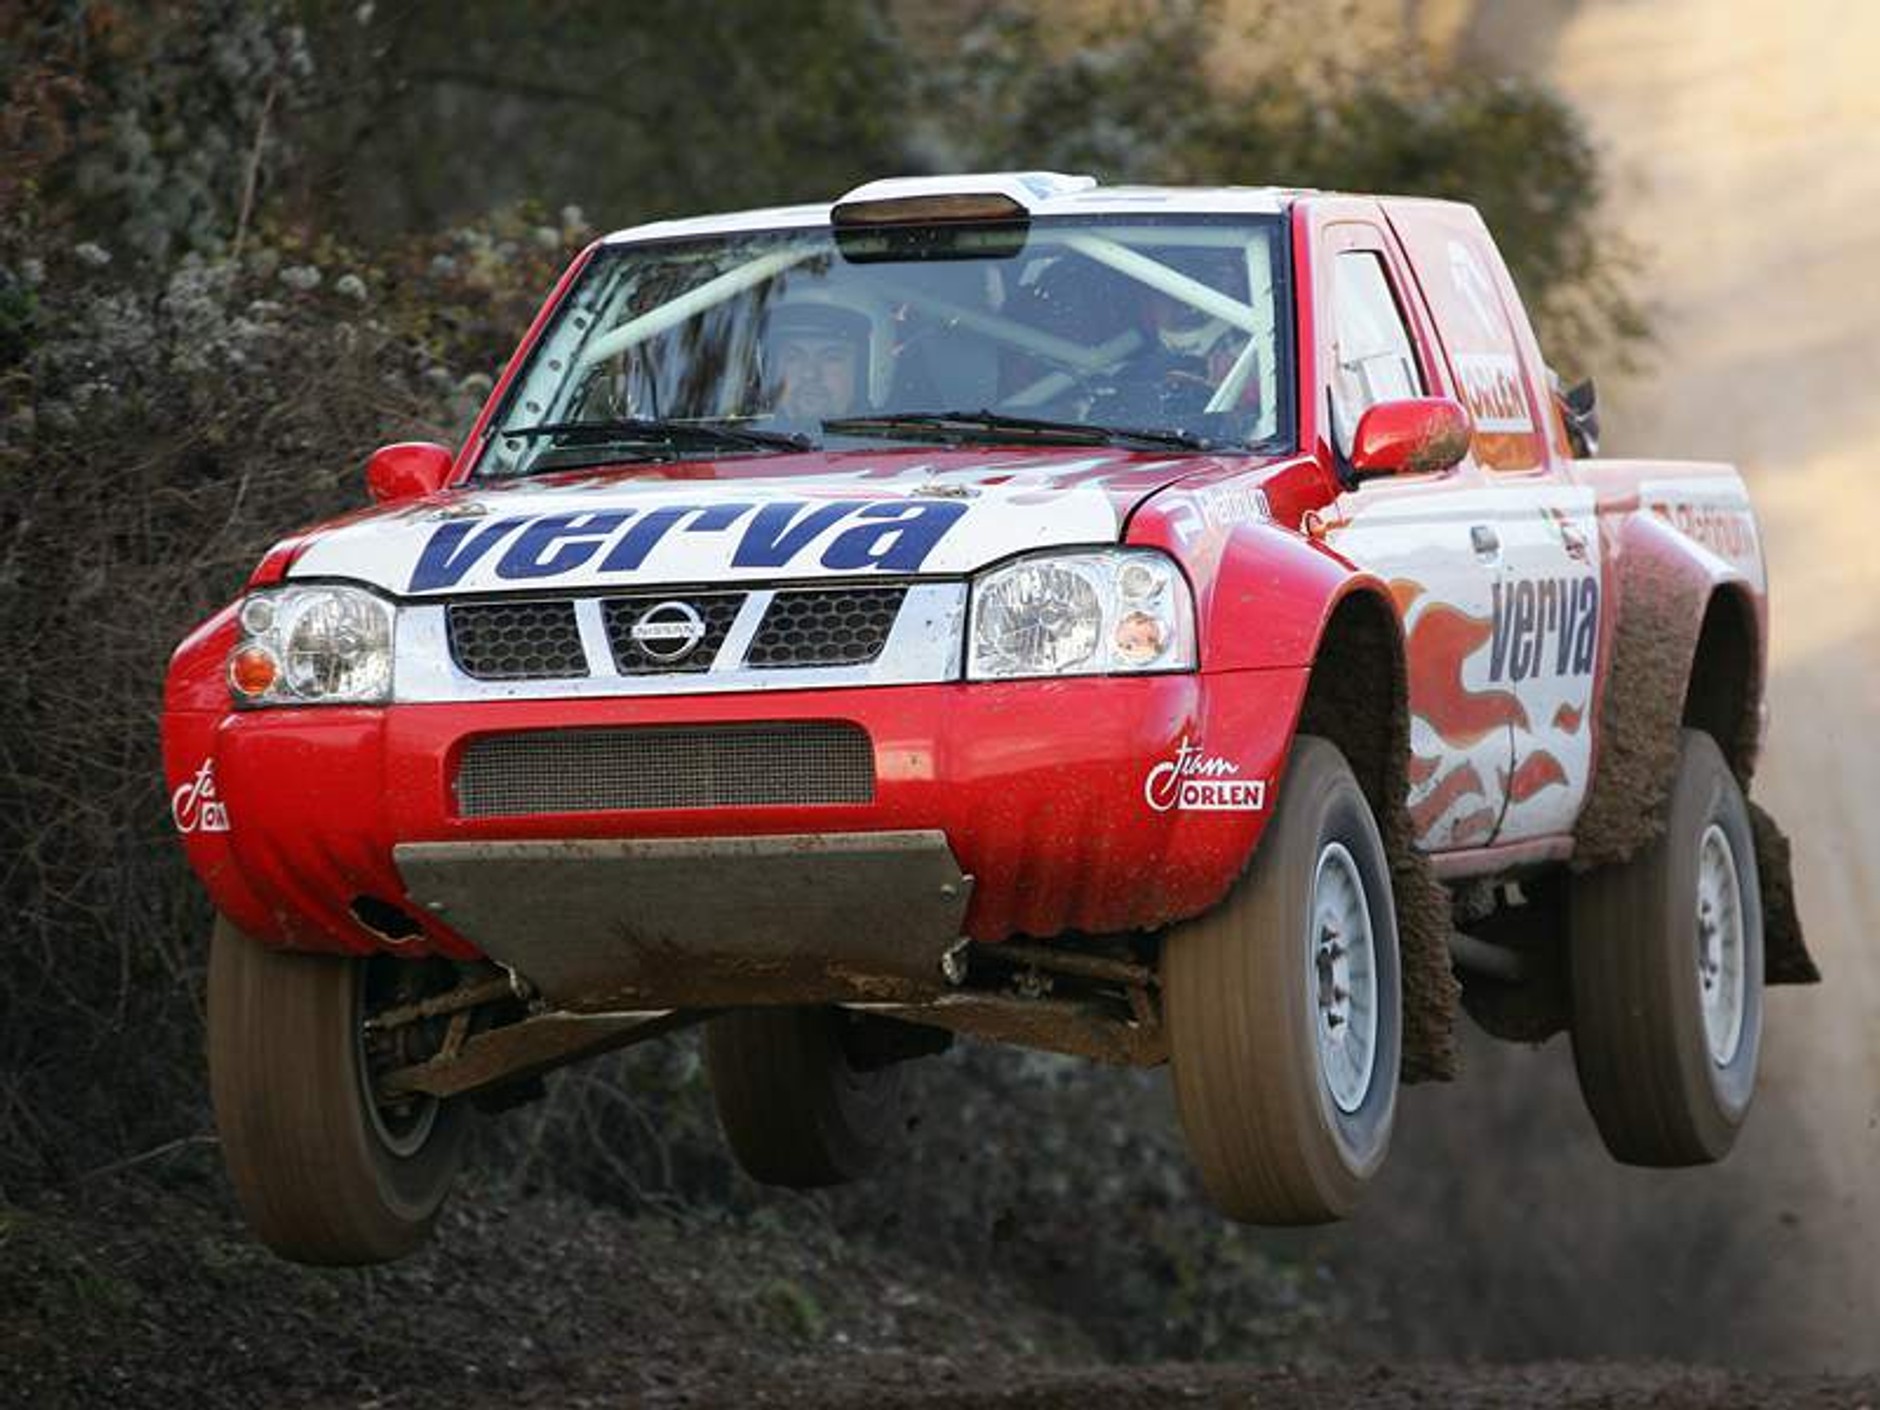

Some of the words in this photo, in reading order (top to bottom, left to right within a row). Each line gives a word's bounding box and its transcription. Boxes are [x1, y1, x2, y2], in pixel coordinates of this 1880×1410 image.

[408, 499, 970, 592] verva
[1488, 576, 1599, 682] verva
[1183, 784, 1260, 806] ORLEN
